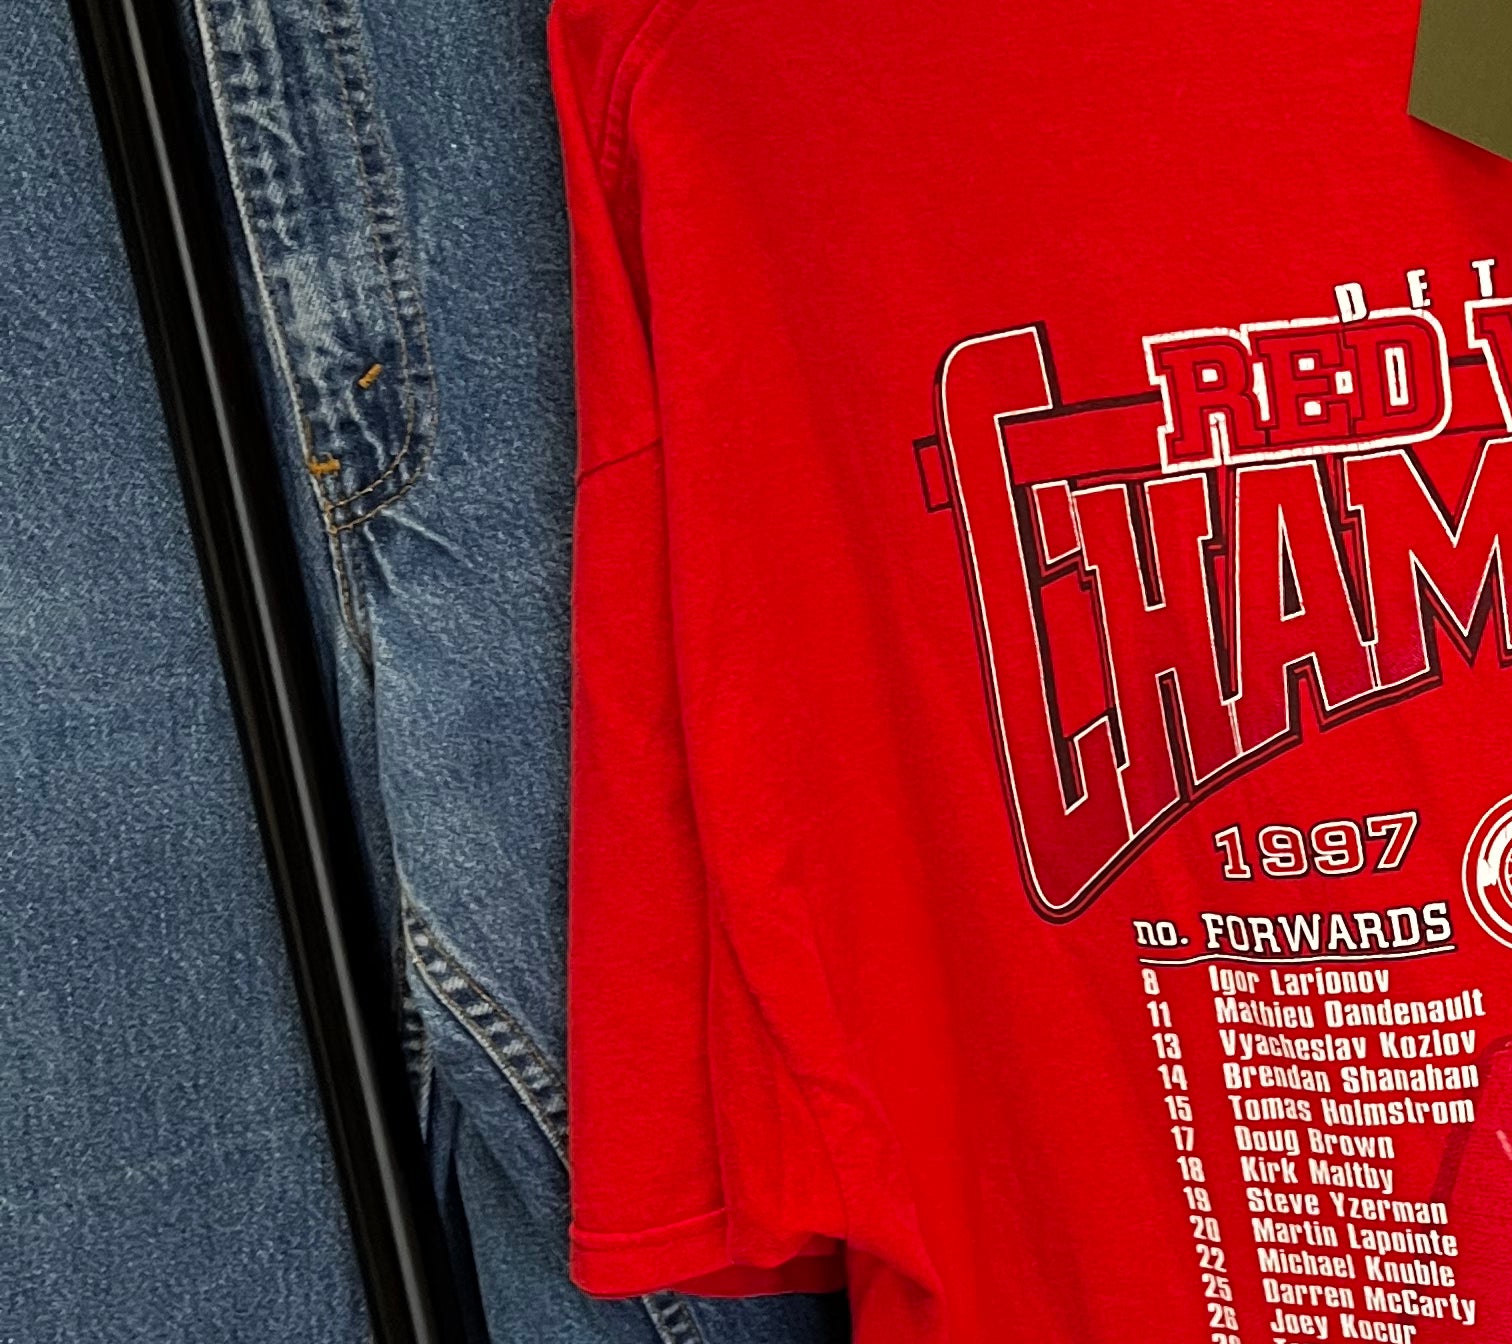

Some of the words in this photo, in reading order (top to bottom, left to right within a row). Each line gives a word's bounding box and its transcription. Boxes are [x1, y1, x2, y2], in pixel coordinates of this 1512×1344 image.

[1143, 308, 1451, 471] RED
[1212, 811, 1419, 883] 1997
[1133, 920, 1189, 947] no.
[1202, 903, 1452, 953] FORWARDS
[1141, 968, 1160, 995] 8
[1209, 966, 1260, 996] Igor
[1271, 968, 1390, 997] Larionov
[1146, 1001, 1173, 1028] 11
[1214, 997, 1315, 1029] Mathieu
[1325, 989, 1486, 1028] Dandenault
[1152, 1033, 1182, 1059] 13
[1219, 1029, 1368, 1062] Vyacheslav
[1379, 1029, 1476, 1059] Kozlov
[1158, 1064, 1188, 1090] 14
[1223, 1062, 1331, 1093] Brendan
[1342, 1063, 1479, 1093] Shanahan
[1164, 1095, 1193, 1122] 15
[1228, 1095, 1312, 1123] Tomas
[1322, 1097, 1475, 1126] Holmstrom
[1171, 1126, 1195, 1152] 17
[1234, 1125, 1300, 1156] Doug
[1309, 1128, 1395, 1159] Brown
[1177, 1157, 1205, 1182] 18
[1240, 1156, 1298, 1185] Kirk
[1309, 1158, 1393, 1194] Maltby
[1183, 1187, 1212, 1212] 19
[1247, 1187, 1320, 1217] Steve
[1331, 1192, 1448, 1225] Yzerman
[1189, 1215, 1221, 1243] 20
[1252, 1218, 1338, 1248] Martin
[1348, 1223, 1458, 1257] Lapointe
[1195, 1245, 1226, 1272] 22
[1257, 1249, 1355, 1279] Michael
[1365, 1256, 1455, 1288] Knuble
[1201, 1274, 1232, 1302] 25
[1263, 1278, 1354, 1310] Darren
[1365, 1286, 1476, 1325] McCarty
[1208, 1304, 1238, 1330] 26
[1270, 1309, 1328, 1340] Joey
